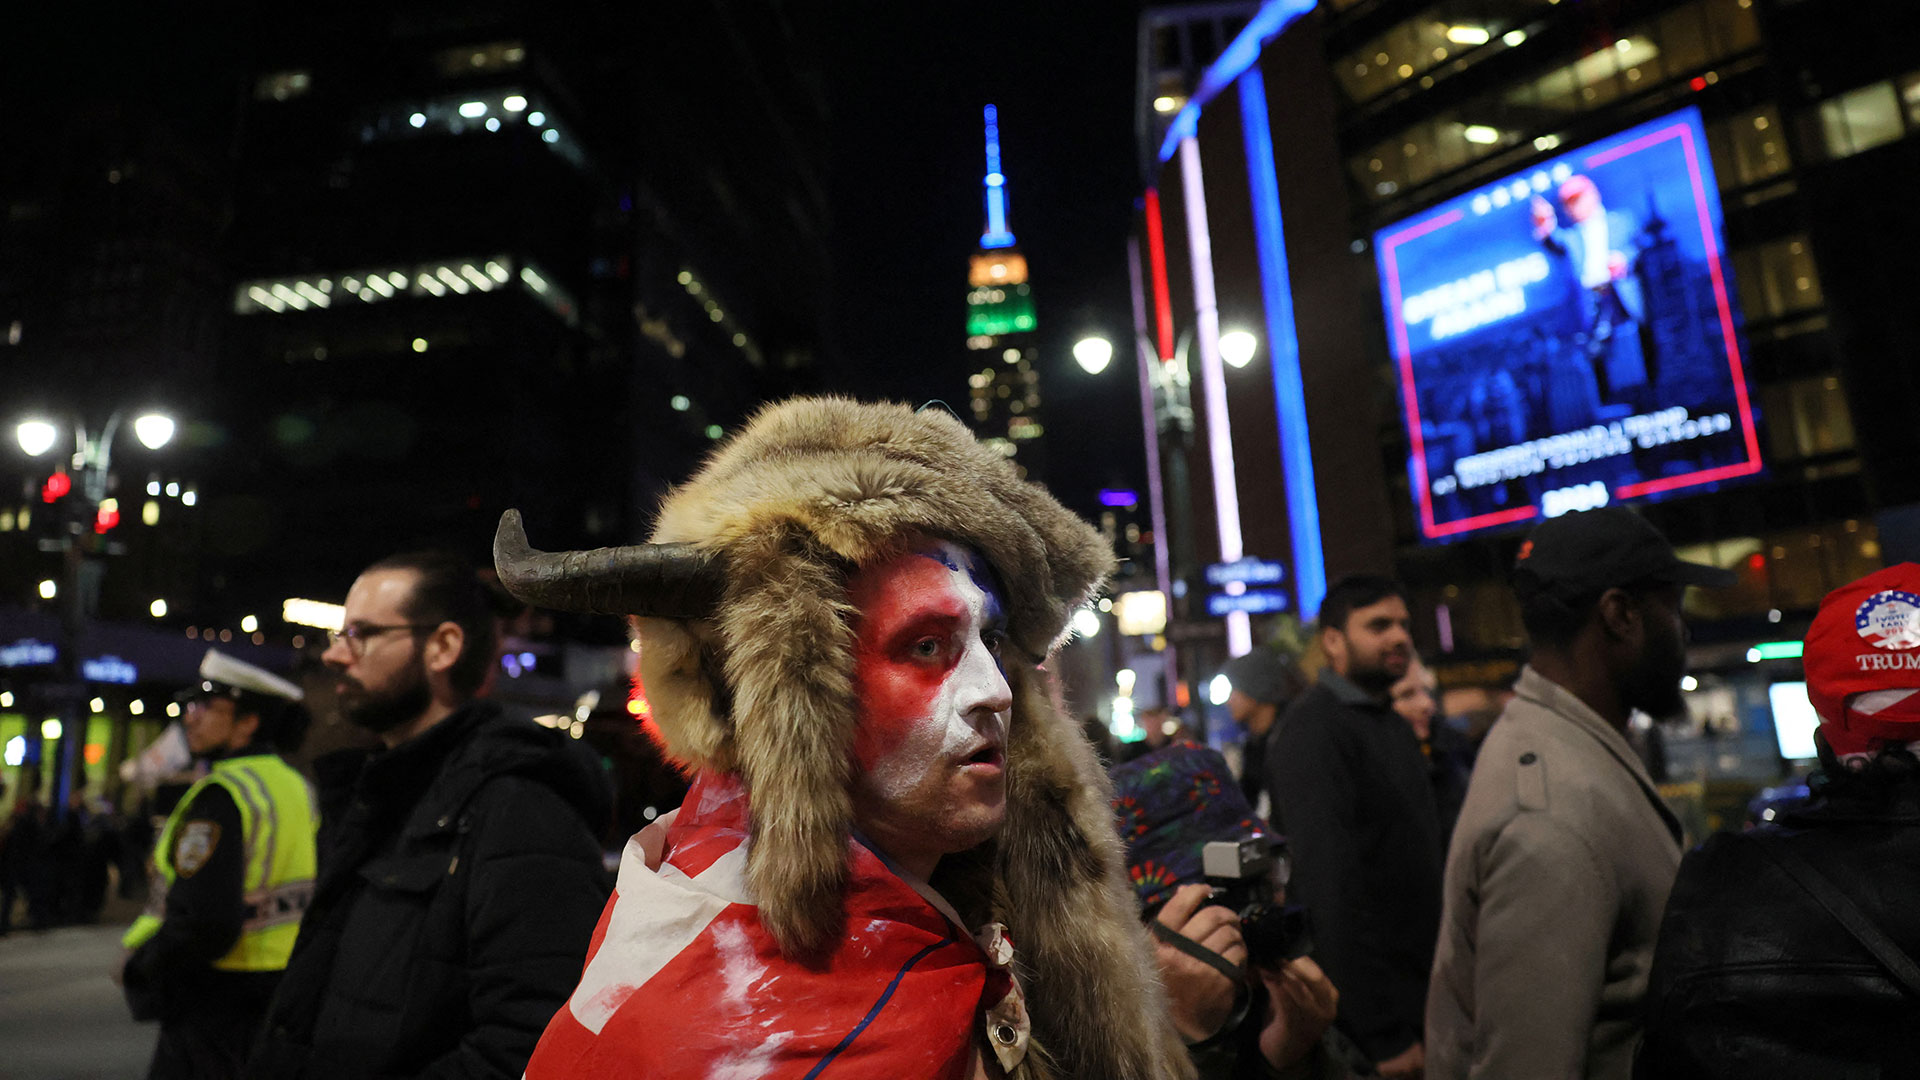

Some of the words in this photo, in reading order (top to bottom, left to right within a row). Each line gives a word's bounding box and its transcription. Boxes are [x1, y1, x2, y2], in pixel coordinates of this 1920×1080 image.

[1881, 614, 1909, 622] VOTE
[1881, 621, 1909, 629] EARL
[1856, 653, 1920, 670] TRUM
